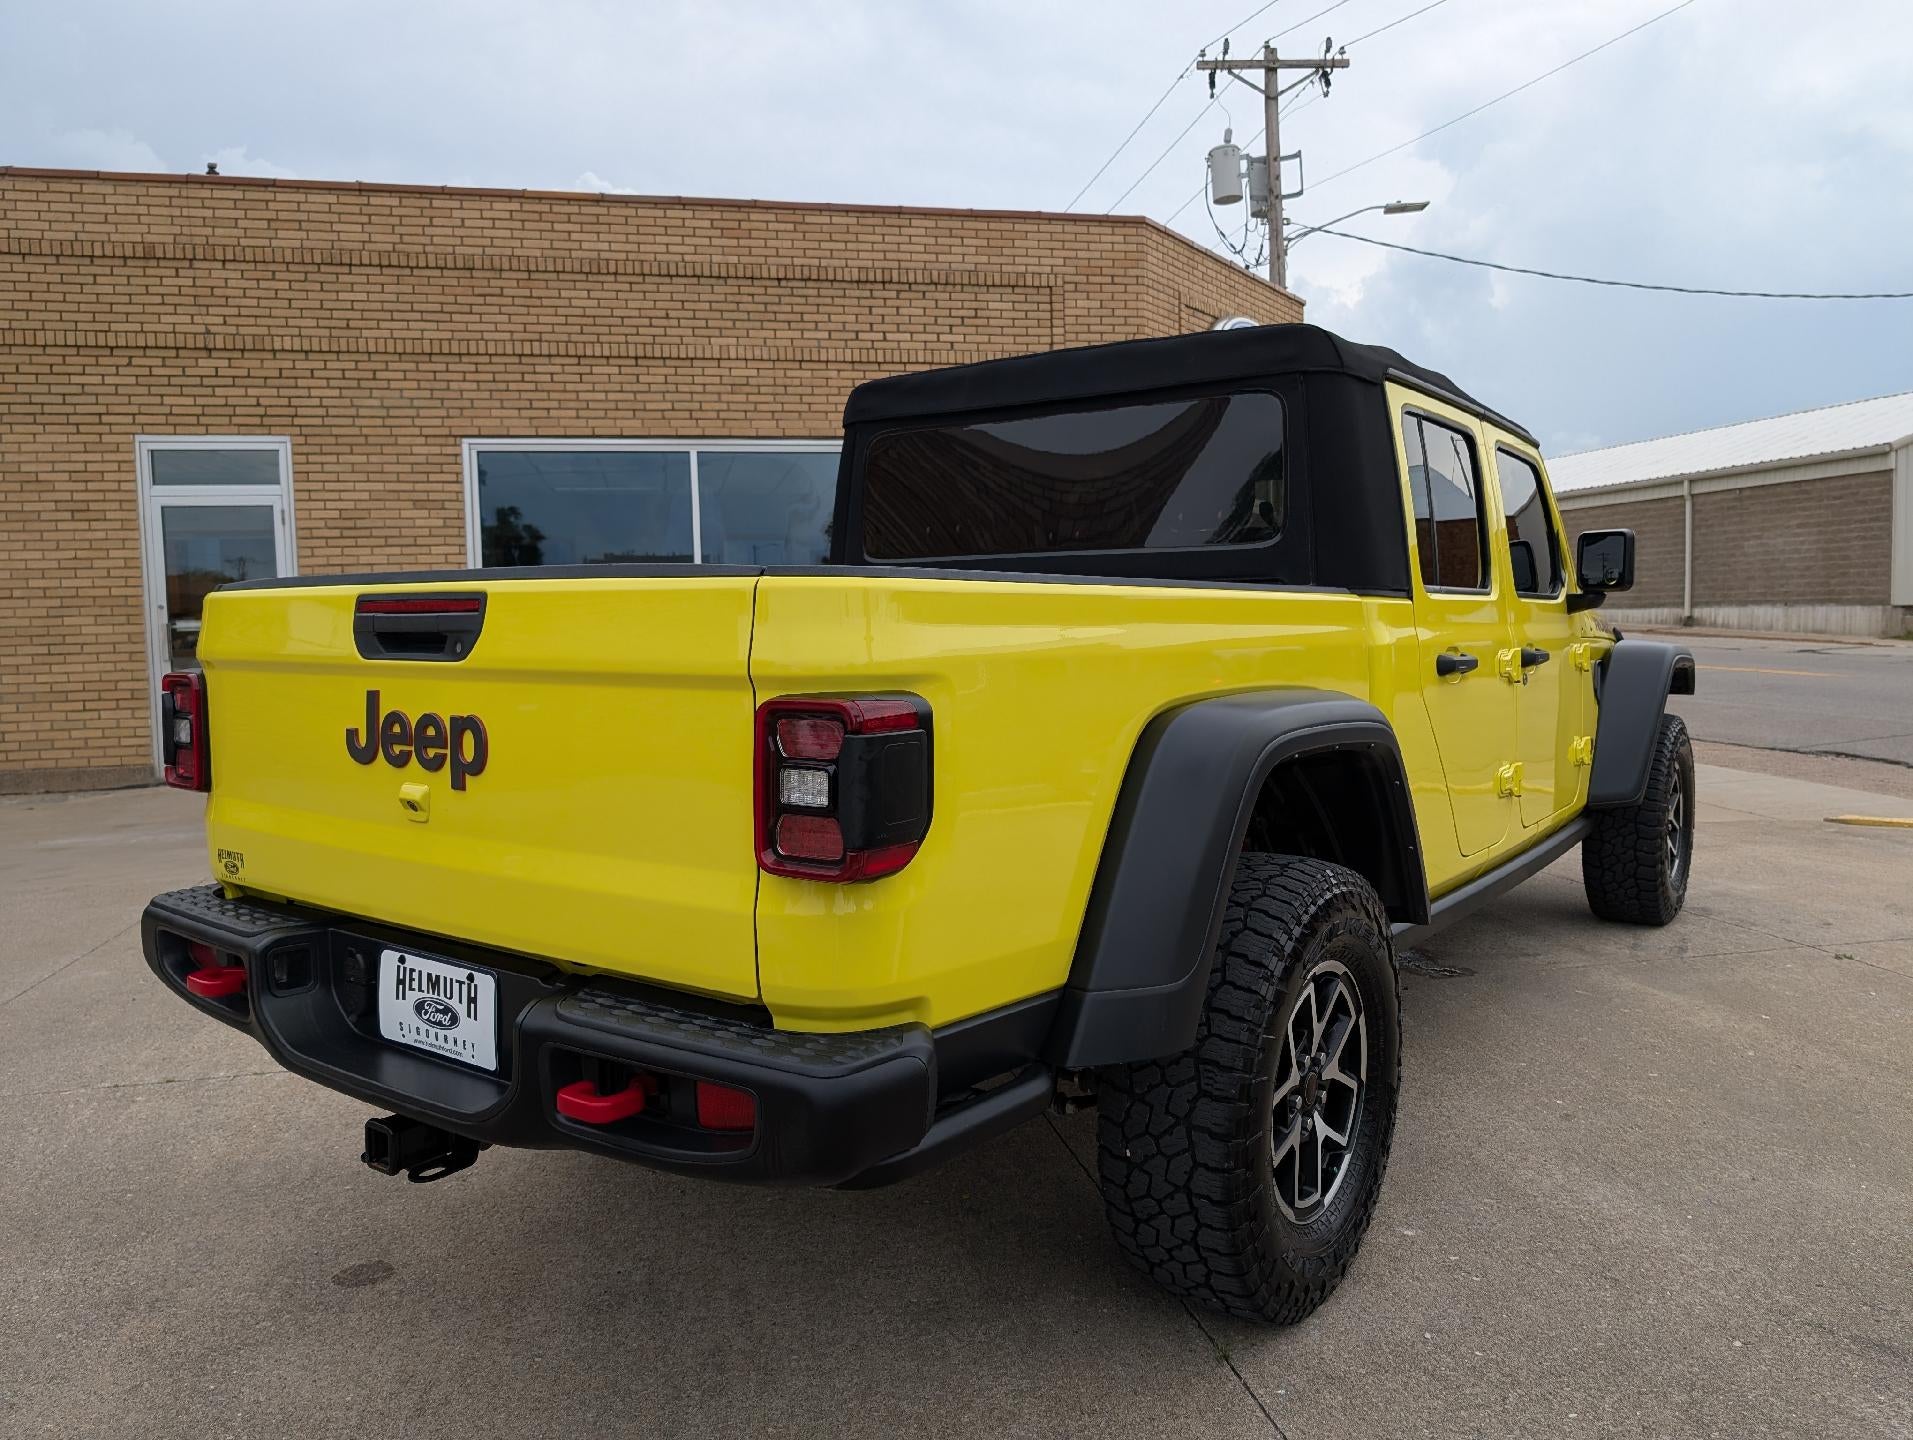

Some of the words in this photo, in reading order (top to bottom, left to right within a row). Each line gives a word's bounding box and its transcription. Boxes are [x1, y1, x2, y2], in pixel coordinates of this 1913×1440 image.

[345, 689, 489, 792] Jeep
[395, 963, 478, 1022] HELMUTH
[421, 1000, 452, 1026] Ford
[398, 1021, 476, 1053] SIGOURNEY
